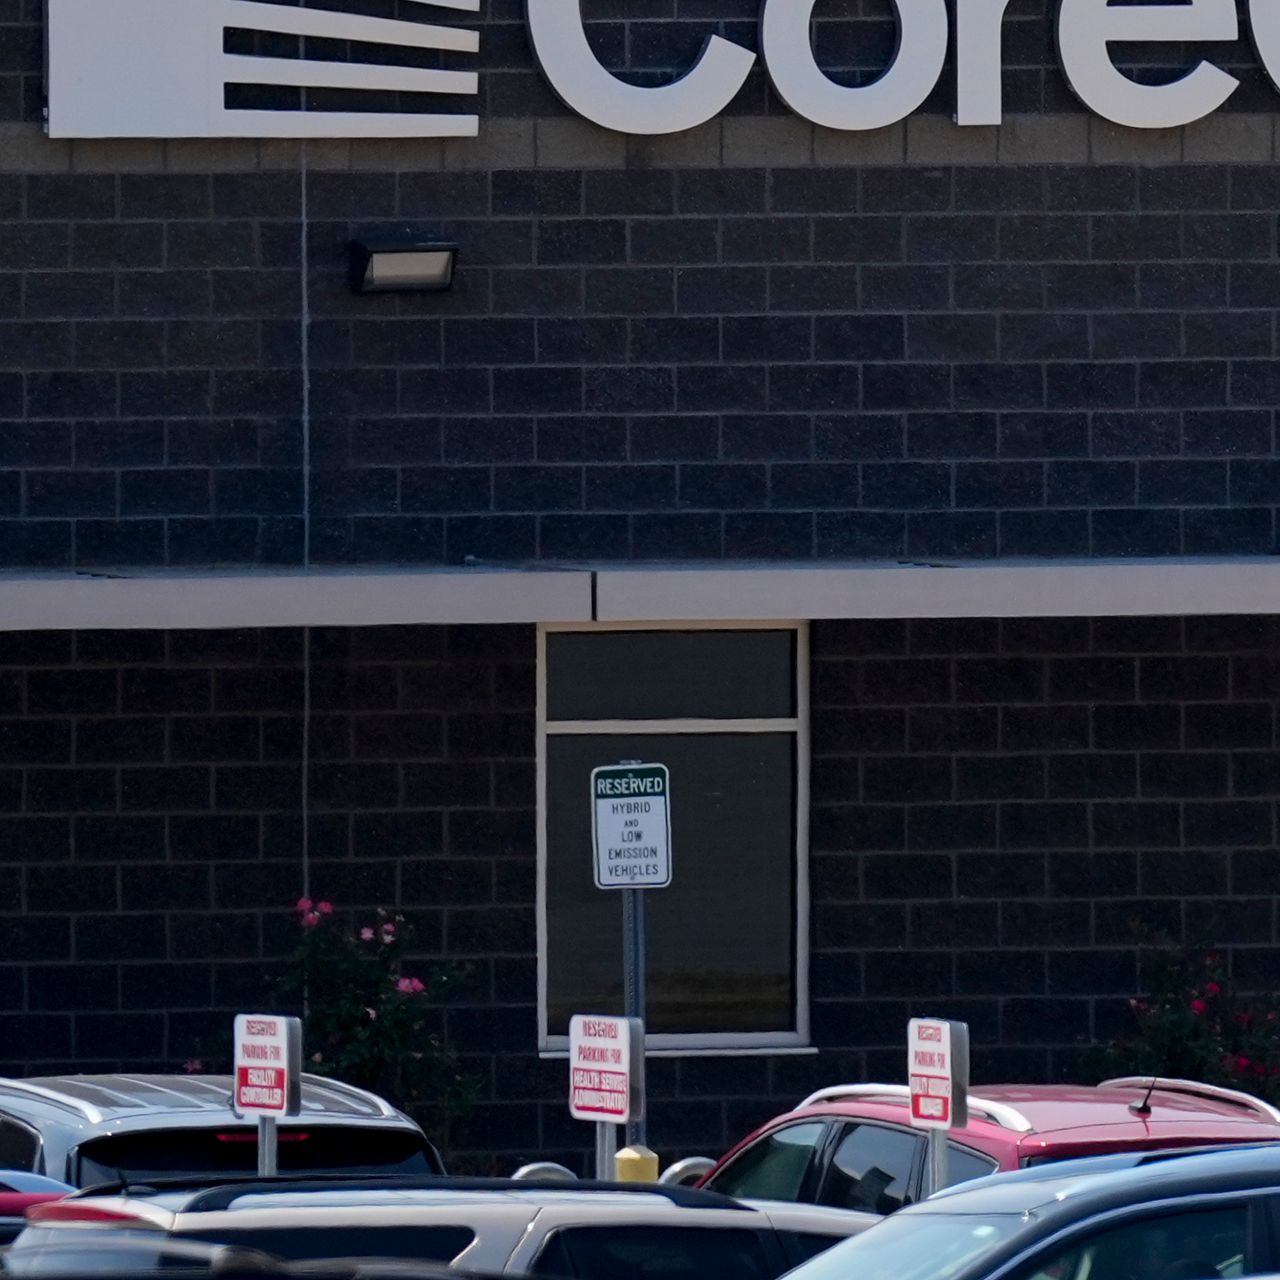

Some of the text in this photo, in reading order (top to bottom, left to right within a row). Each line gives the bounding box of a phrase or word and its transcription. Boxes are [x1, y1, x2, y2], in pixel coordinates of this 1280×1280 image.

[597, 777, 663, 795] RESERVED
[612, 802, 651, 815] HYBRID
[624, 819, 639, 828] AND
[621, 831, 643, 842] LOW
[608, 847, 658, 860] EMISSION
[608, 864, 659, 877] VEHICLES
